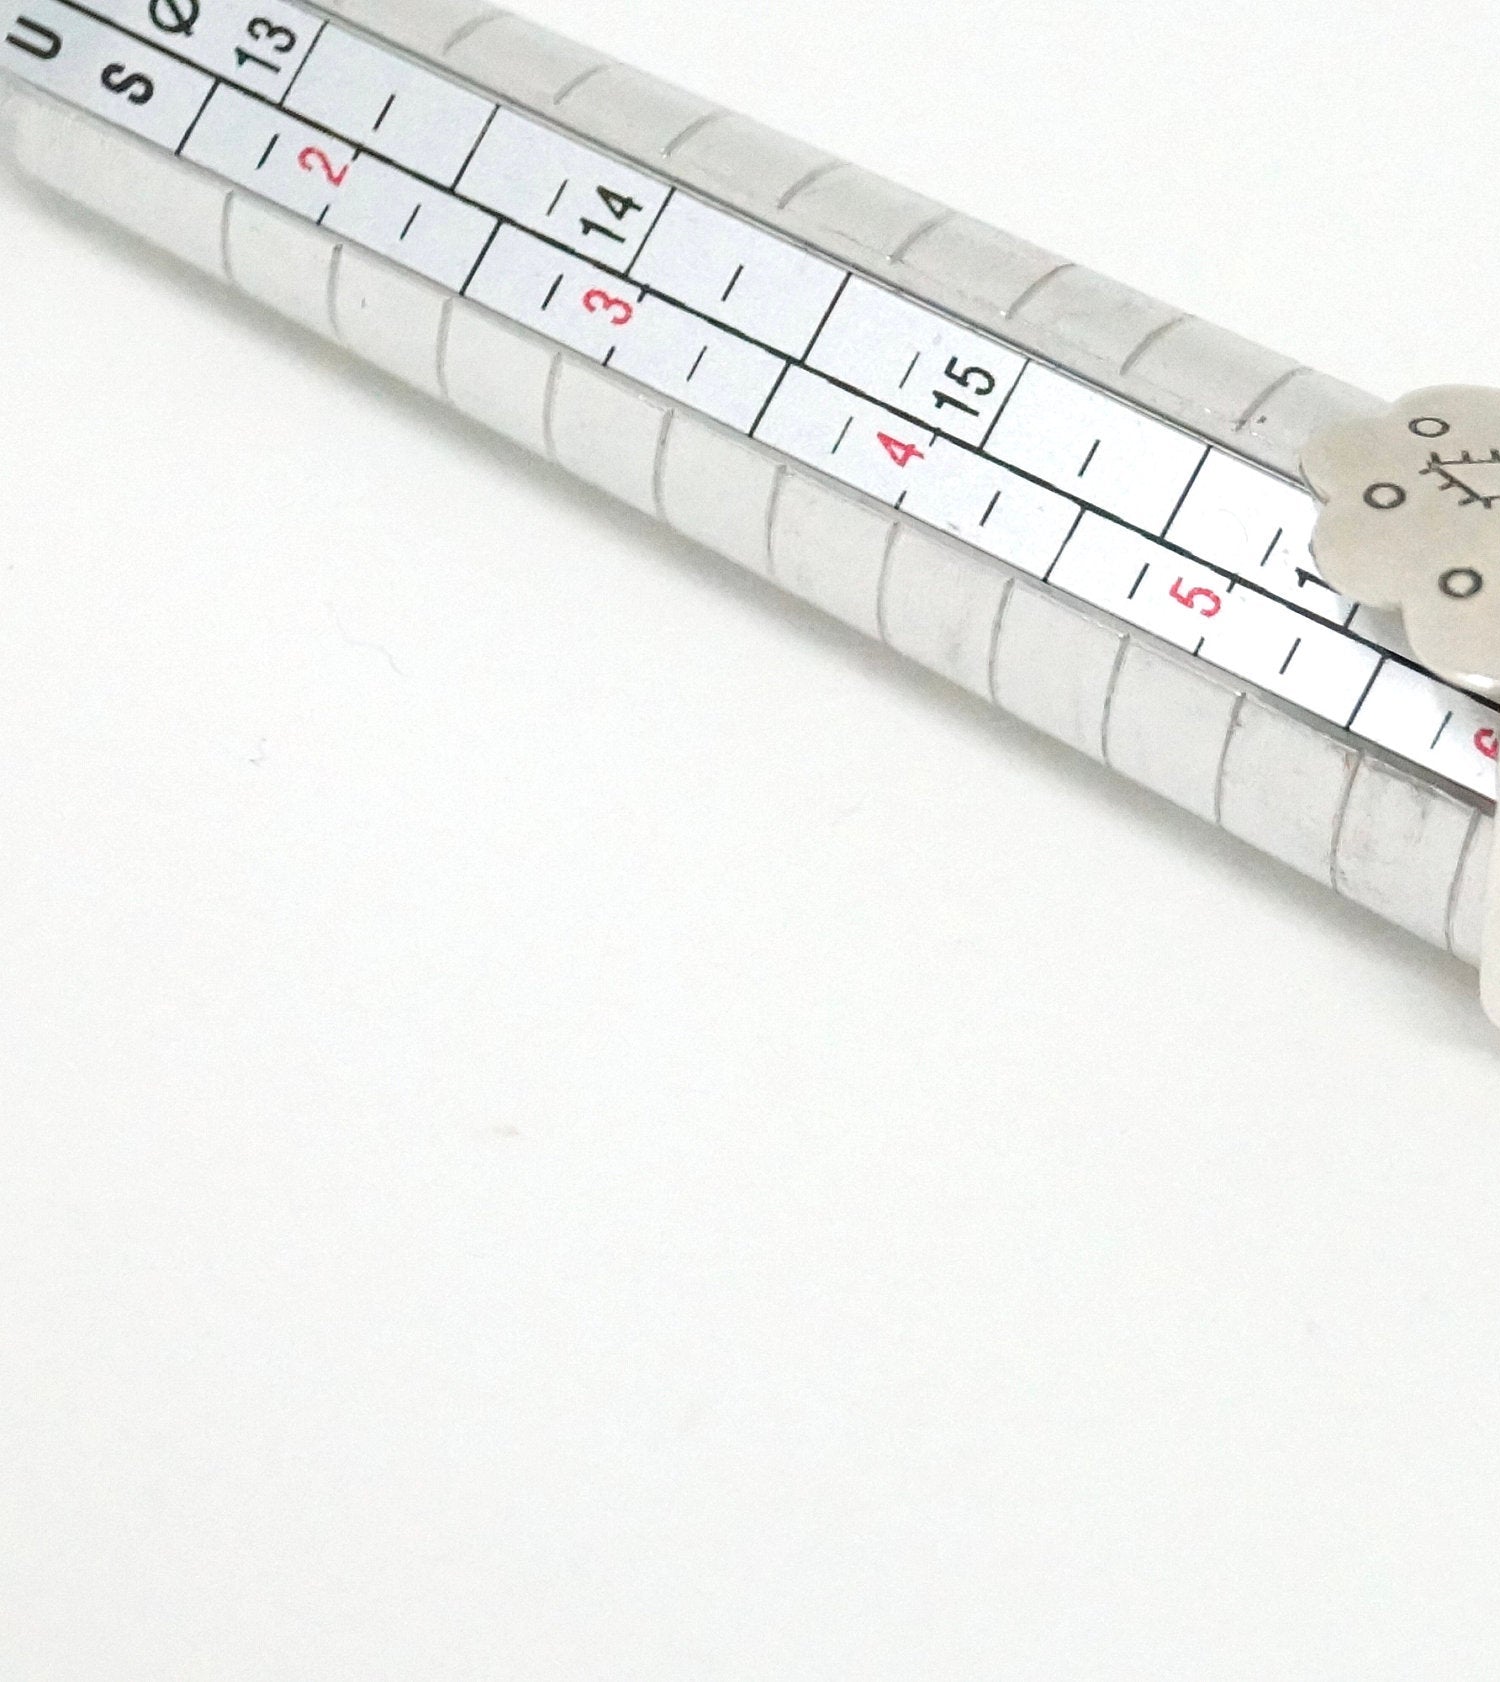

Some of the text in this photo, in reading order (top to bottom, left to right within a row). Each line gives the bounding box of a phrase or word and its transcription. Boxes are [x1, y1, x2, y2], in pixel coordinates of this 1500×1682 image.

[234, 16, 298, 75] 13
[297, 145, 350, 188] 2
[579, 184, 644, 244] 14
[582, 288, 634, 326] 3
[932, 356, 996, 417] 15
[876, 431, 925, 468] 4
[1168, 576, 1223, 618] 5
